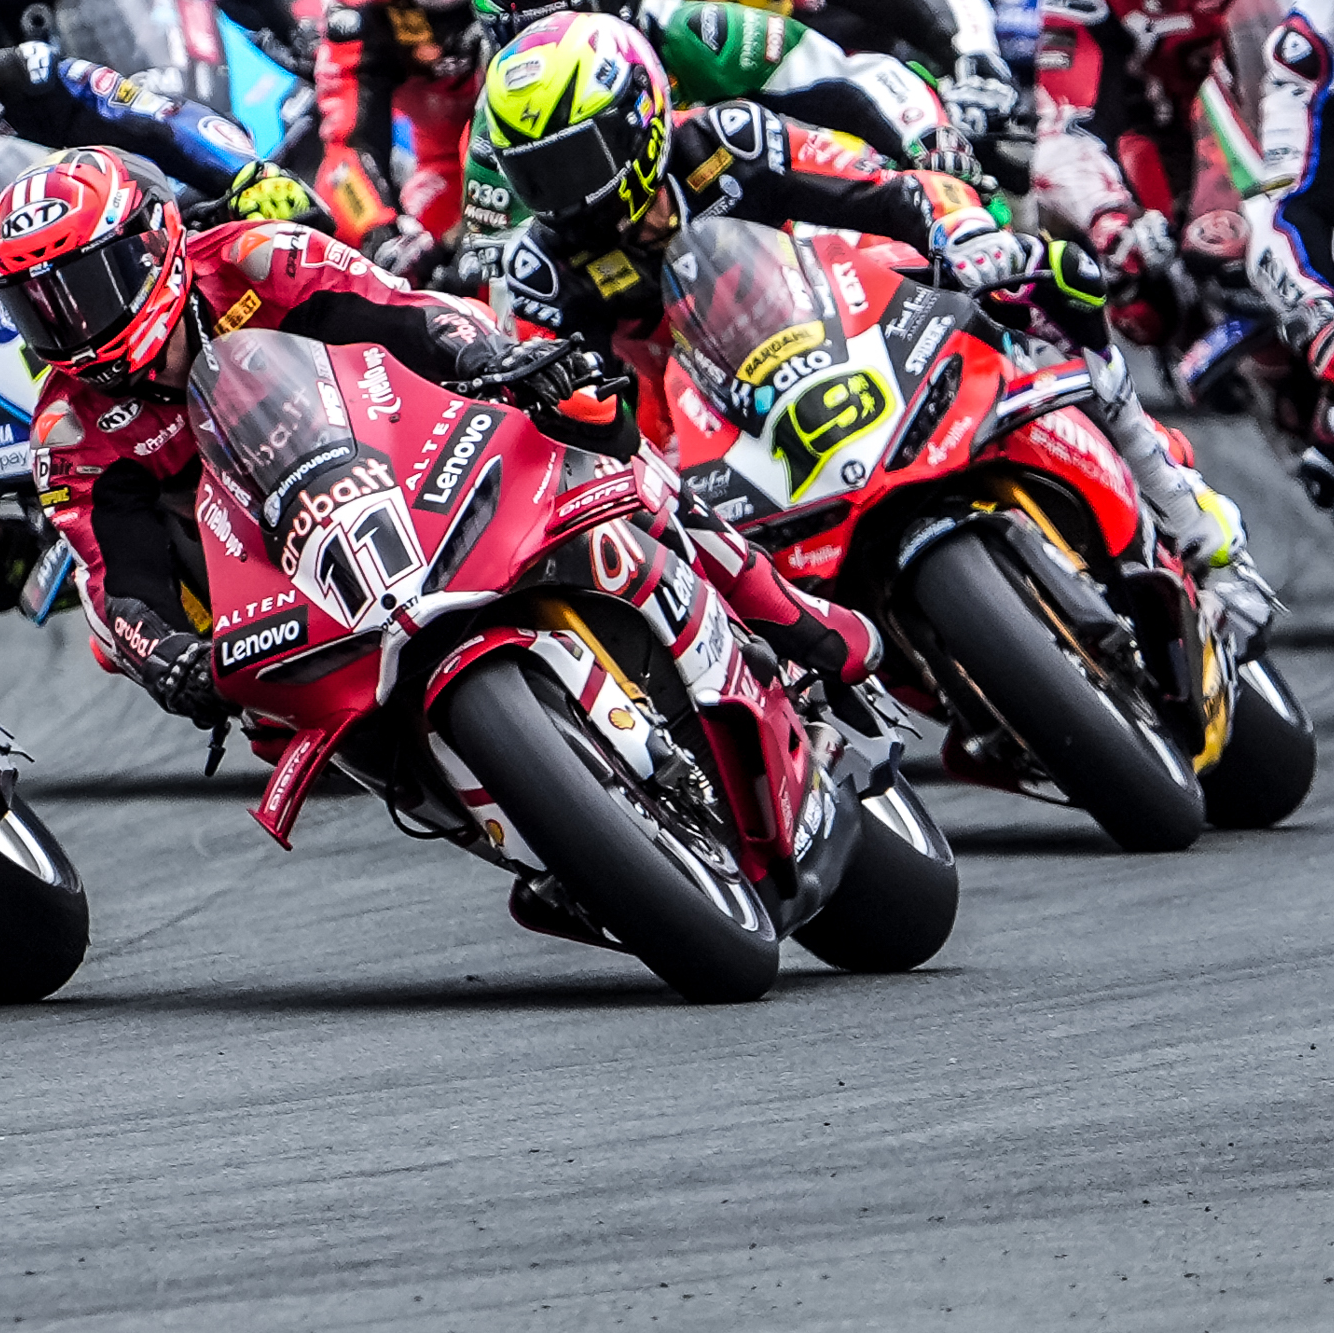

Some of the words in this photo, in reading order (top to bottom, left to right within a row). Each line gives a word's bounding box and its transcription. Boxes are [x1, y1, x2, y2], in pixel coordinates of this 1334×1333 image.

[2, 202, 67, 239] KYT
[772, 349, 833, 394] dto
[404, 398, 465, 492] ALTEN
[422, 412, 494, 507] Lenovo
[771, 368, 897, 505] 19
[280, 456, 395, 577] aruba.it
[558, 481, 631, 518] Dierre
[314, 498, 425, 626] 11
[213, 589, 296, 633] ALTEN
[220, 619, 301, 668] Lenovo
